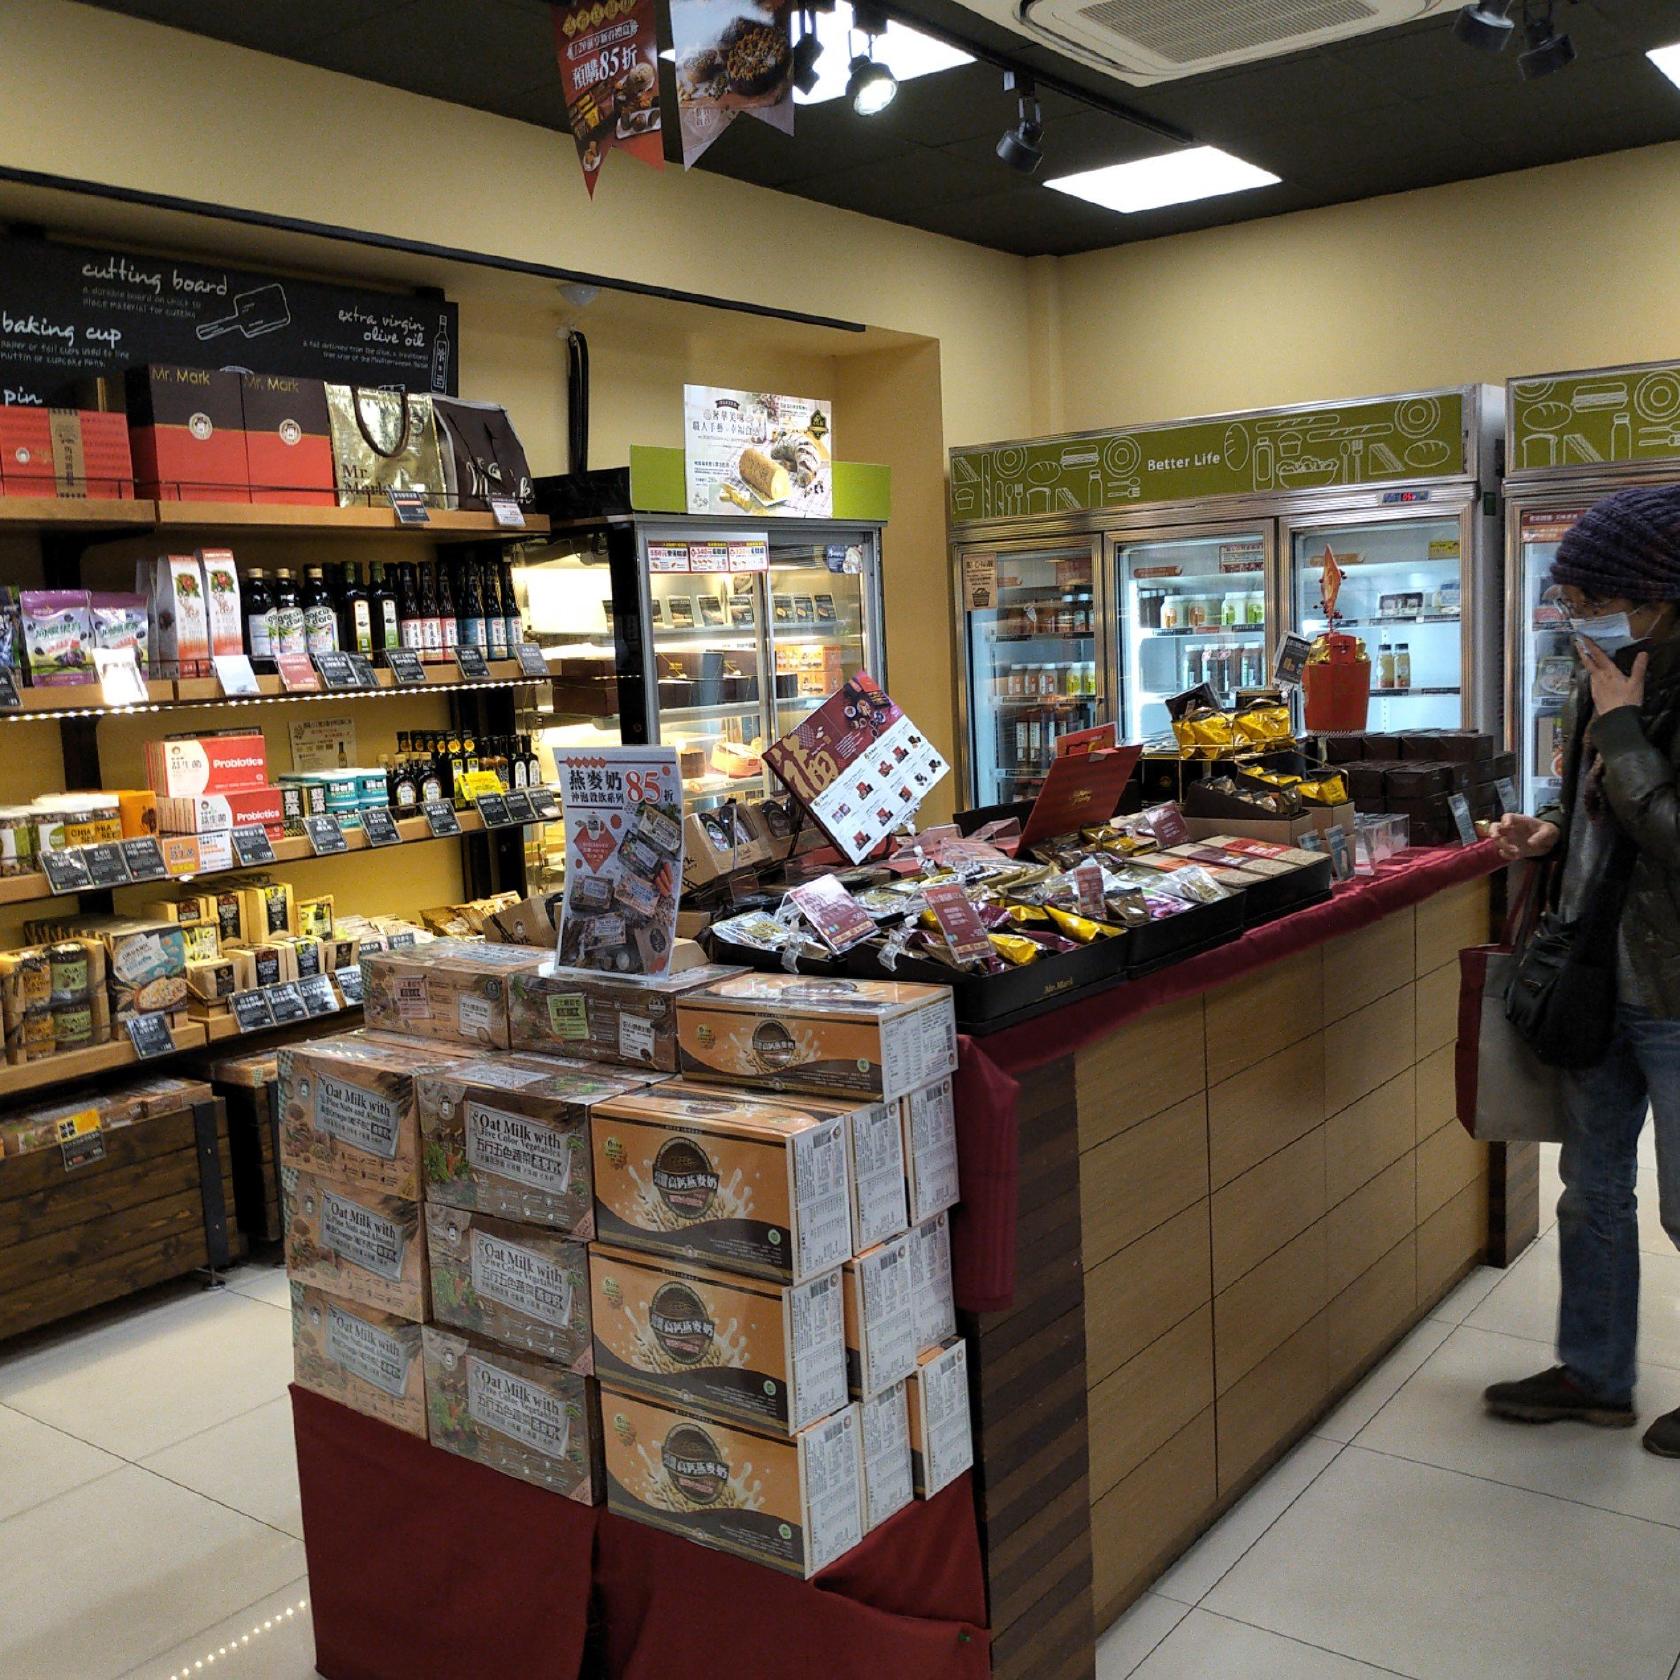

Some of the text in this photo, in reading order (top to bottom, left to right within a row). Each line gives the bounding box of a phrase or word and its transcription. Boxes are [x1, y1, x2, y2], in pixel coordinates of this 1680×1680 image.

[82, 257, 228, 296] cutting board
[3, 311, 122, 349] baking cup
[338, 305, 424, 336] extra virgin
[363, 326, 425, 347] olive oil
[176, 370, 211, 386] Mark
[268, 377, 299, 393] Mark
[4, 386, 42, 407] pin
[1147, 452, 1220, 472] Better Life
[213, 758, 264, 769] Probiotics
[569, 770, 622, 791] 燕麥奶
[236, 811, 280, 822] Probiotics
[326, 1084, 391, 1117] Oat Milk with
[480, 1113, 561, 1150] Oat Milk with
[331, 1202, 396, 1238] Oat Milk with
[485, 1243, 563, 1284] Oat Milk with
[337, 1317, 400, 1357] Oat Milk with
[481, 1370, 560, 1415] Oat Milk with
